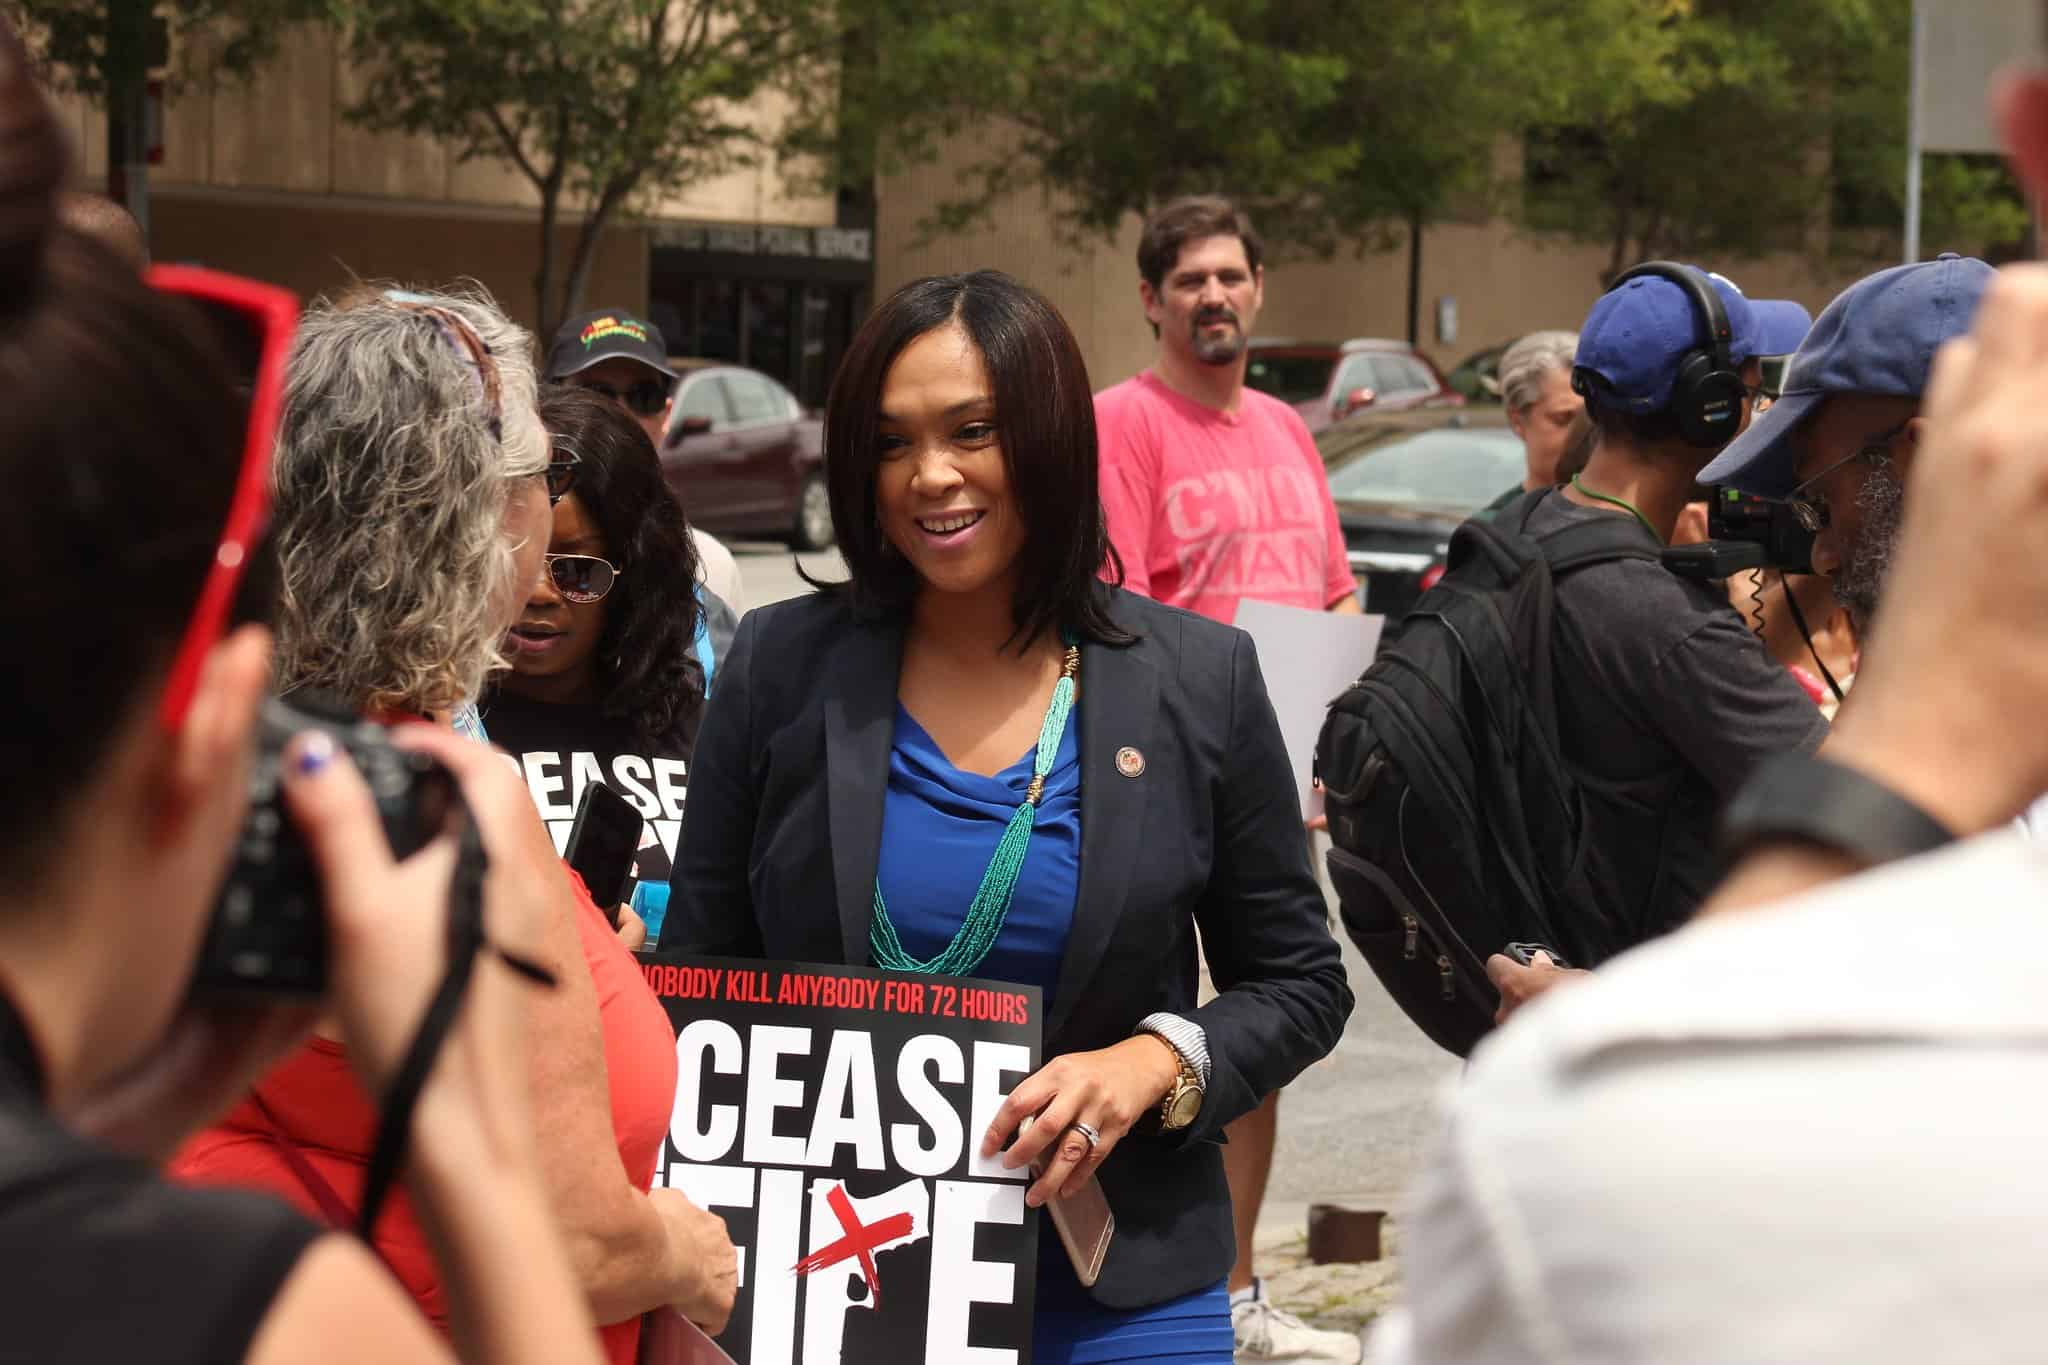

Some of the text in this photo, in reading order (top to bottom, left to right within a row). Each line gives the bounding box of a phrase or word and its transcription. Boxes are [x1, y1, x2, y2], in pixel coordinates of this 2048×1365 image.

[497, 751, 687, 820] EASE
[726, 969, 773, 1003] KILL
[777, 974, 880, 1011] ANYBODY
[883, 981, 924, 1014] FOR
[930, 984, 956, 1017] 72
[960, 987, 1029, 1025] HOURS
[668, 1019, 1031, 1180] CEASE
